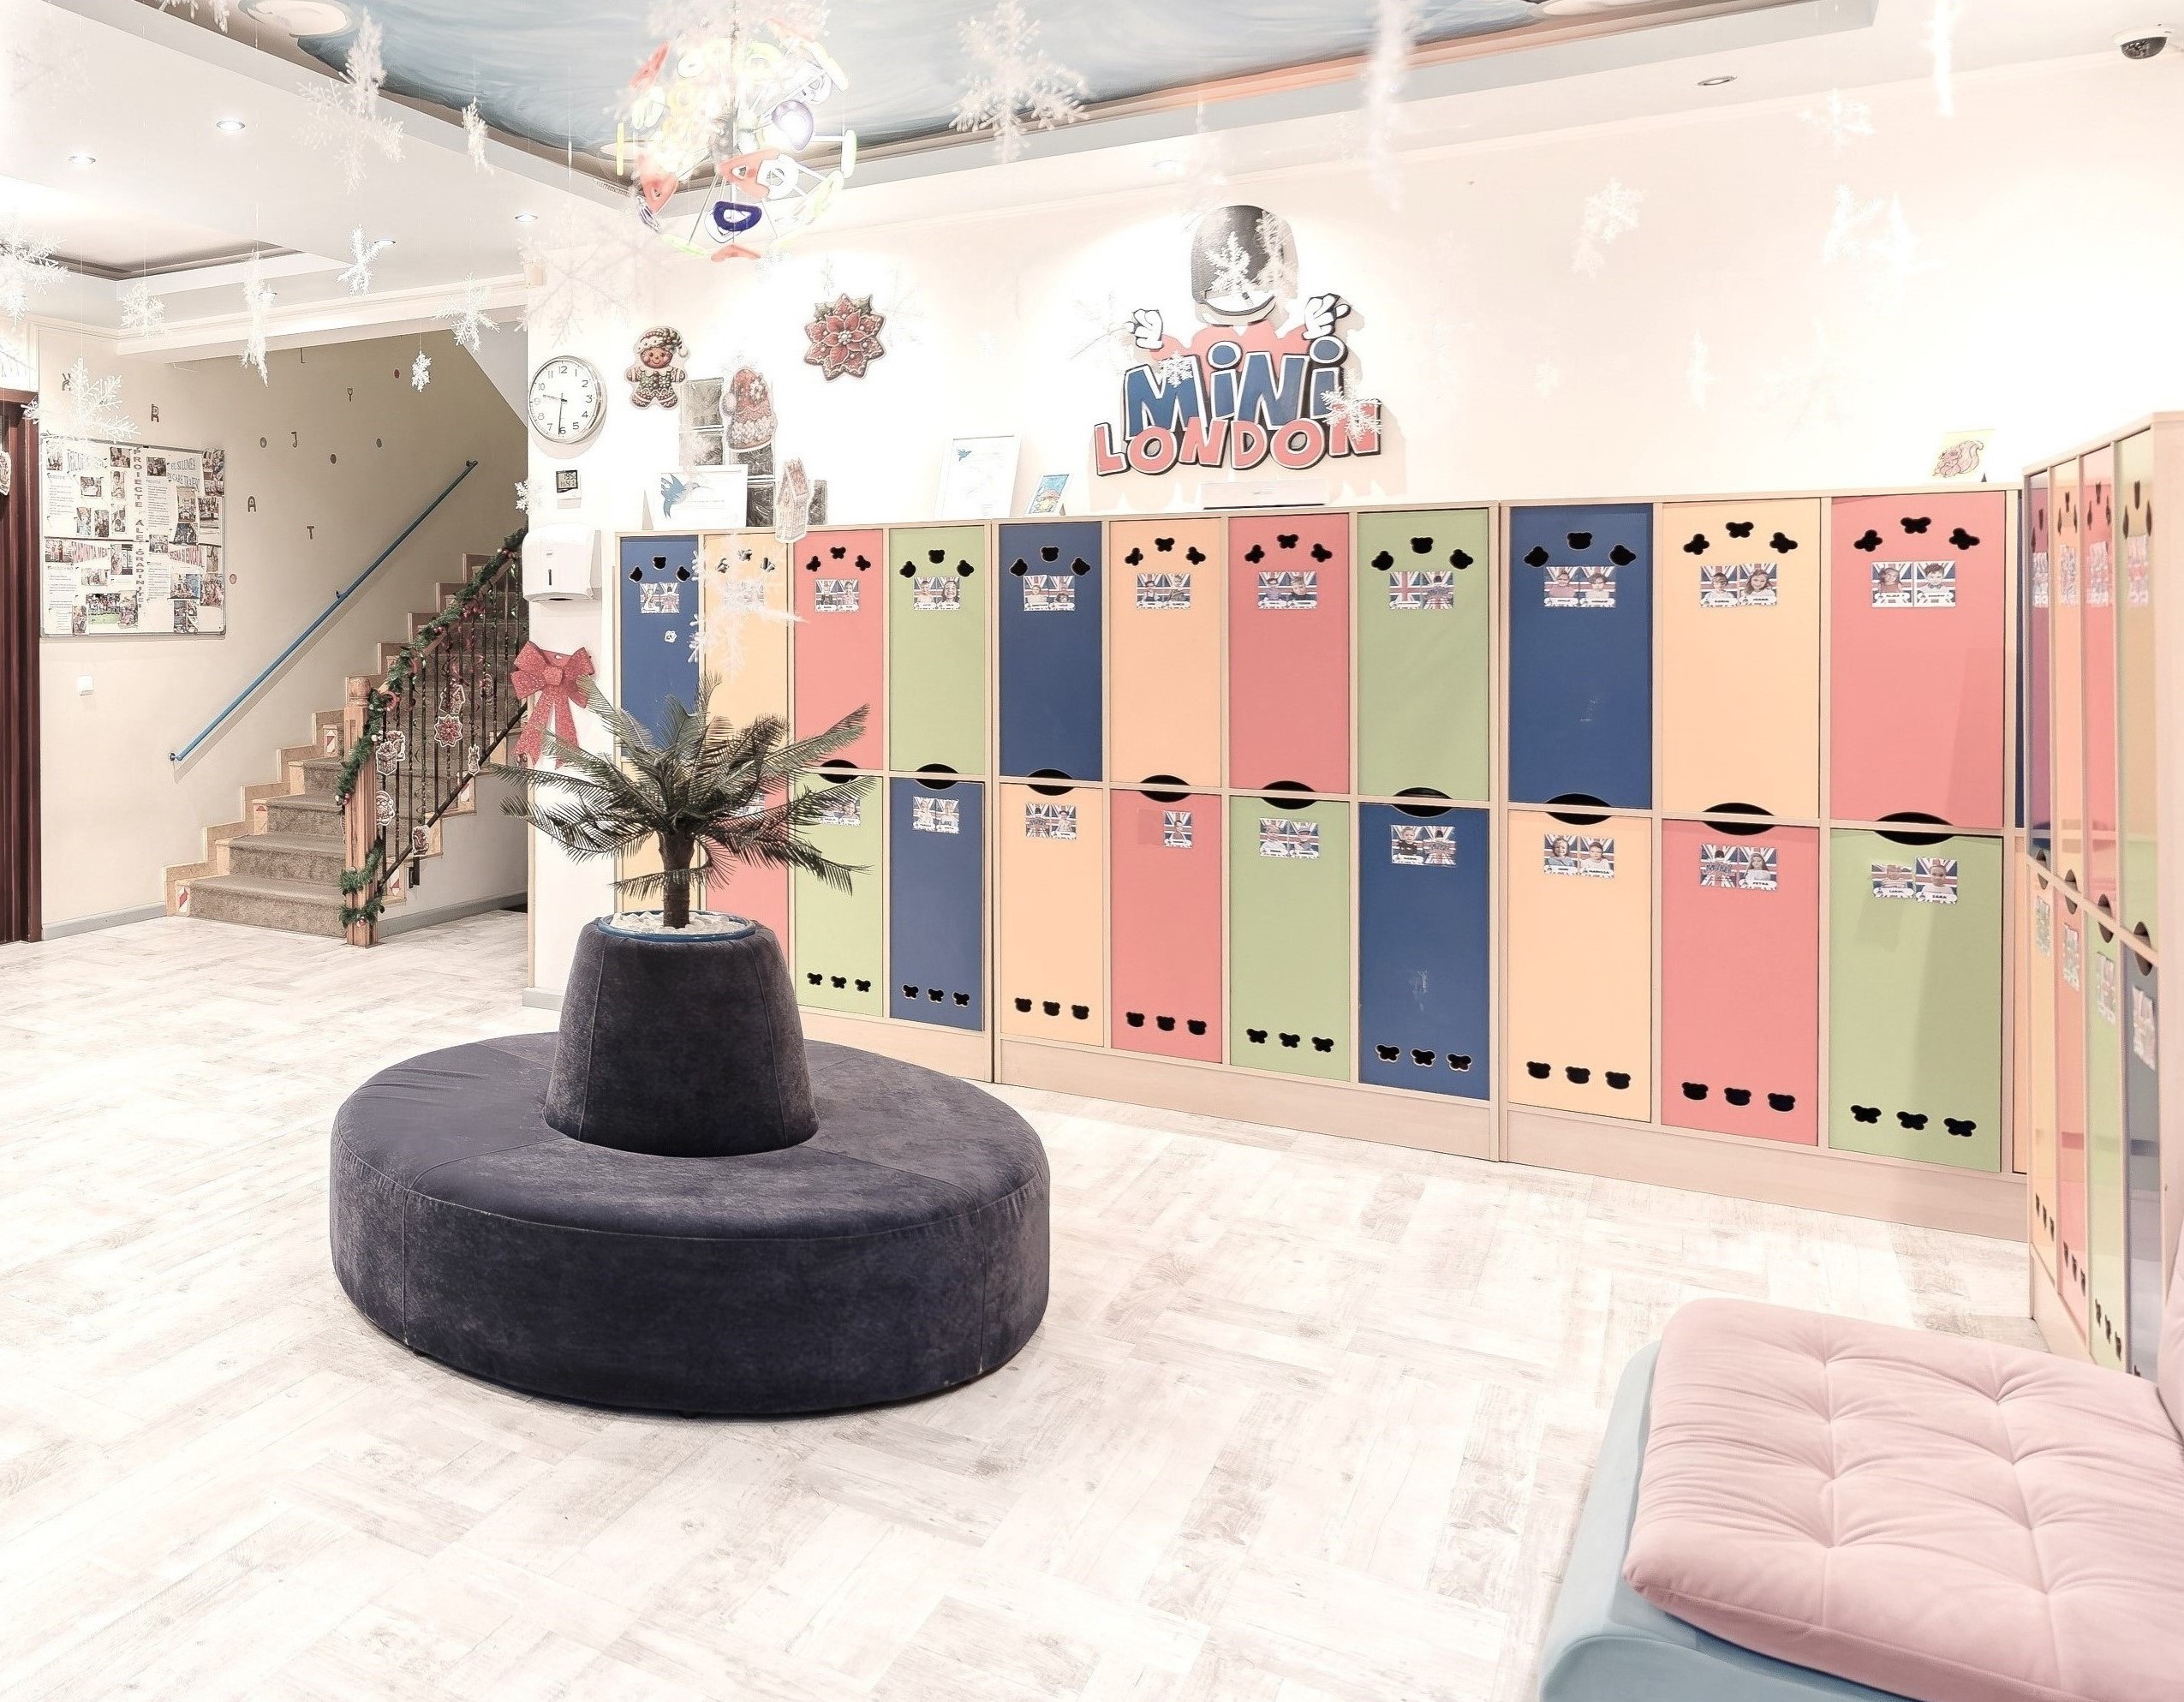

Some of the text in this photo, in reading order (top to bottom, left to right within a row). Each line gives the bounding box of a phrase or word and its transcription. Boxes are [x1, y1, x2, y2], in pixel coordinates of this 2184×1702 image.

[558, 366, 568, 374] 12
[538, 383, 546, 391] 10
[582, 379, 589, 388] 2
[534, 397, 541, 406] 9
[586, 395, 593, 403] 3
[538, 412, 545, 421] 8
[582, 410, 589, 419] 4
[546, 423, 553, 432] 7
[559, 427, 567, 435] 6
[1095, 399, 1381, 476] LONDON
[248, 496, 257, 512] A
[307, 526, 314, 540] T
